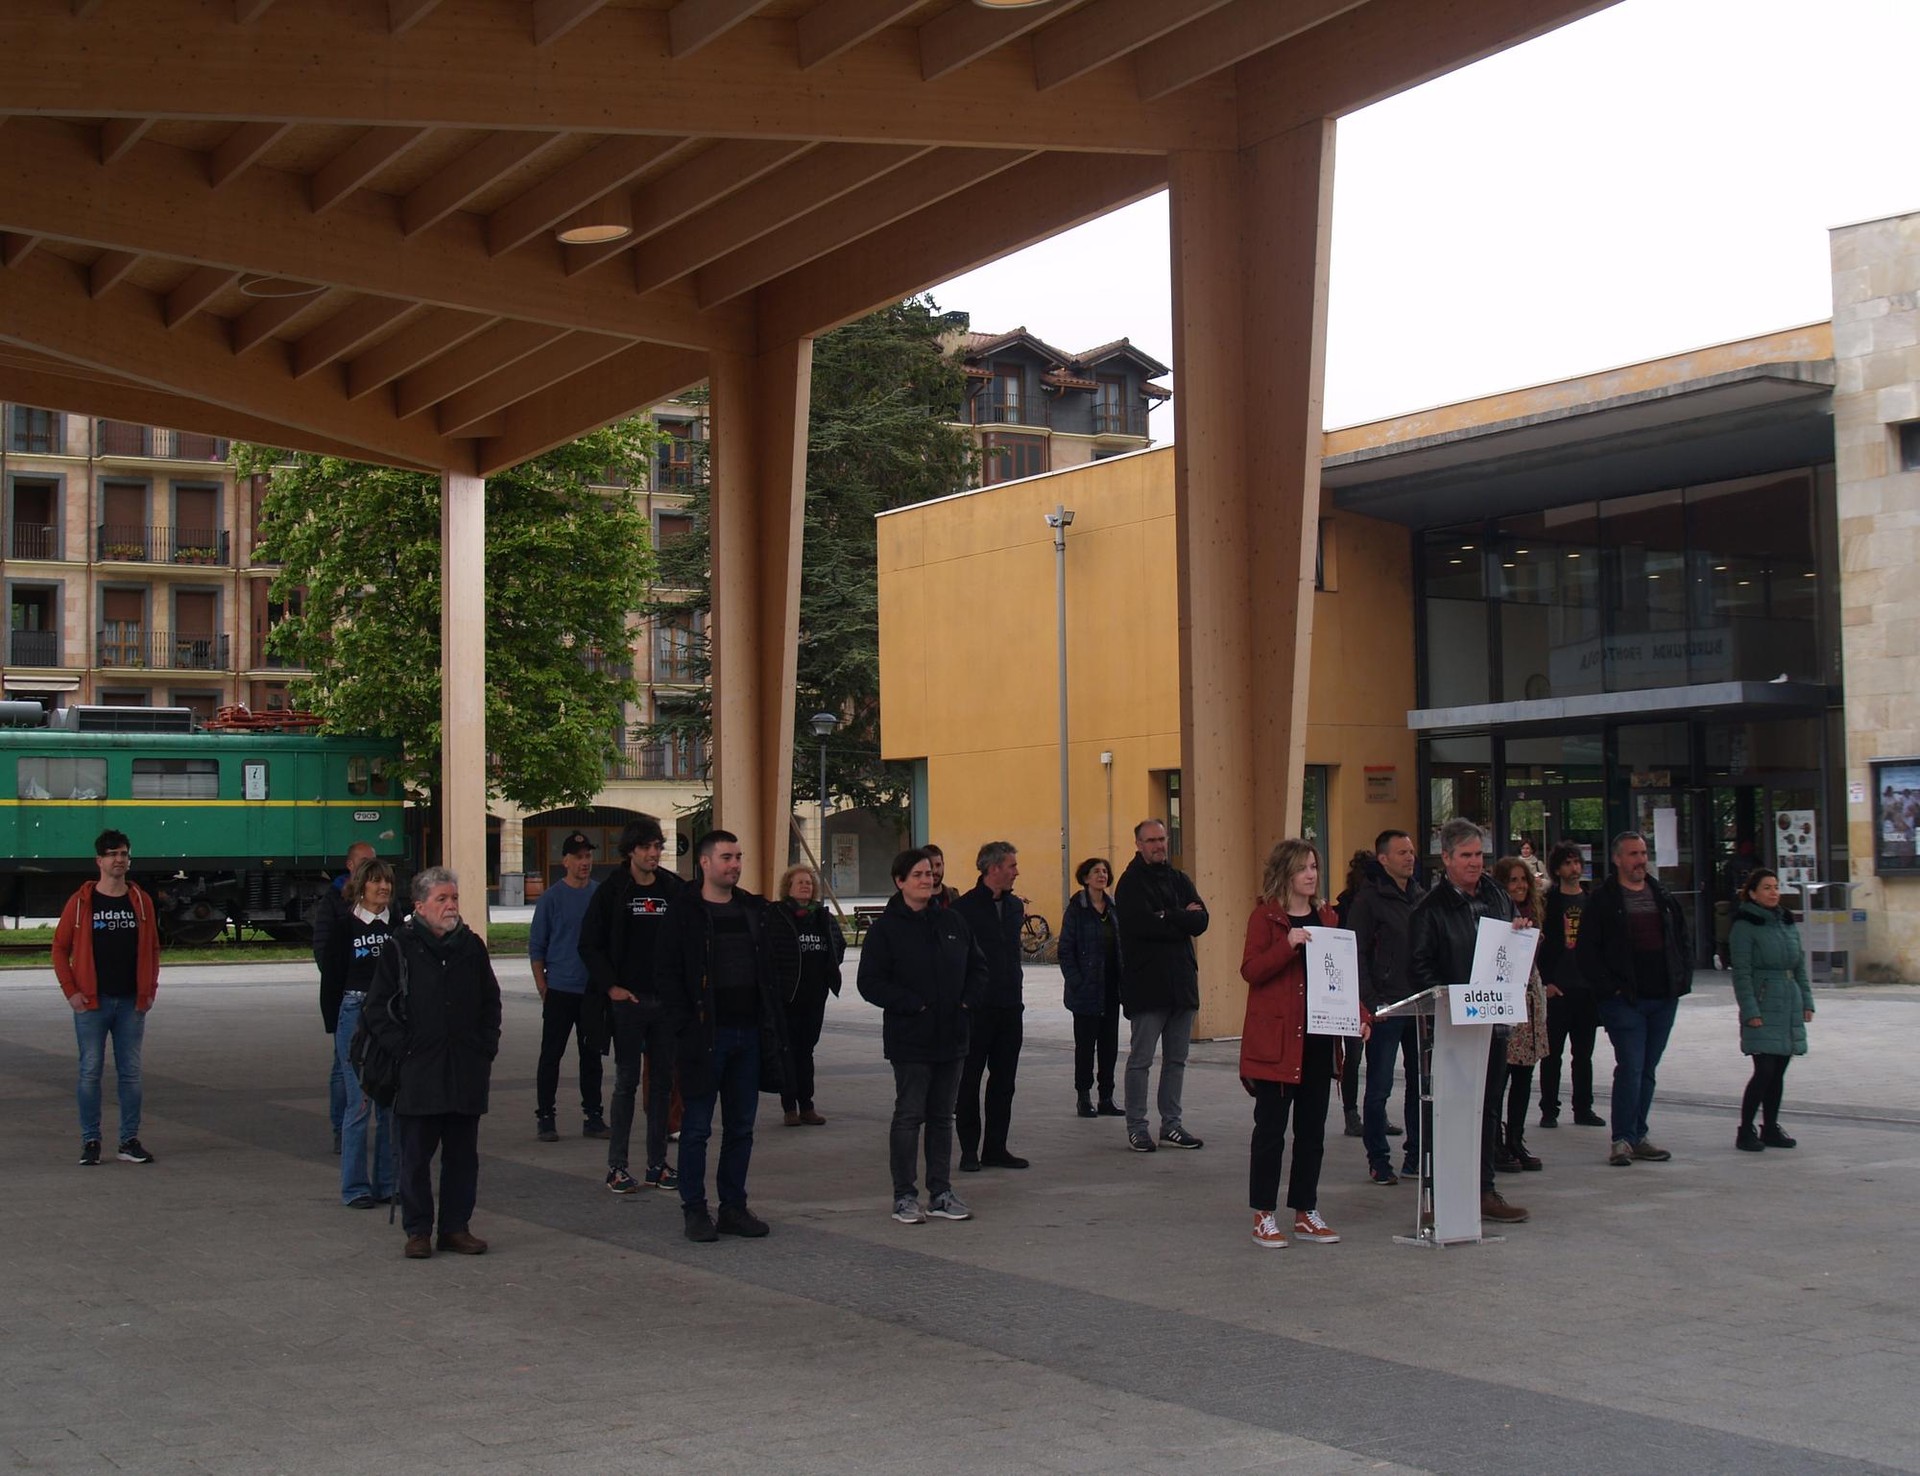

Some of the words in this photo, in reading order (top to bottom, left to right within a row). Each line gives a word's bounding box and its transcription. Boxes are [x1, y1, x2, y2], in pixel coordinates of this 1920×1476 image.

[356, 812, 378, 820] 7903
[93, 910, 134, 920] aldatu
[107, 920, 137, 930] gido
[799, 933, 820, 942] datu
[1464, 990, 1503, 1002] aldatu
[1479, 1003, 1513, 1018] gidoia
